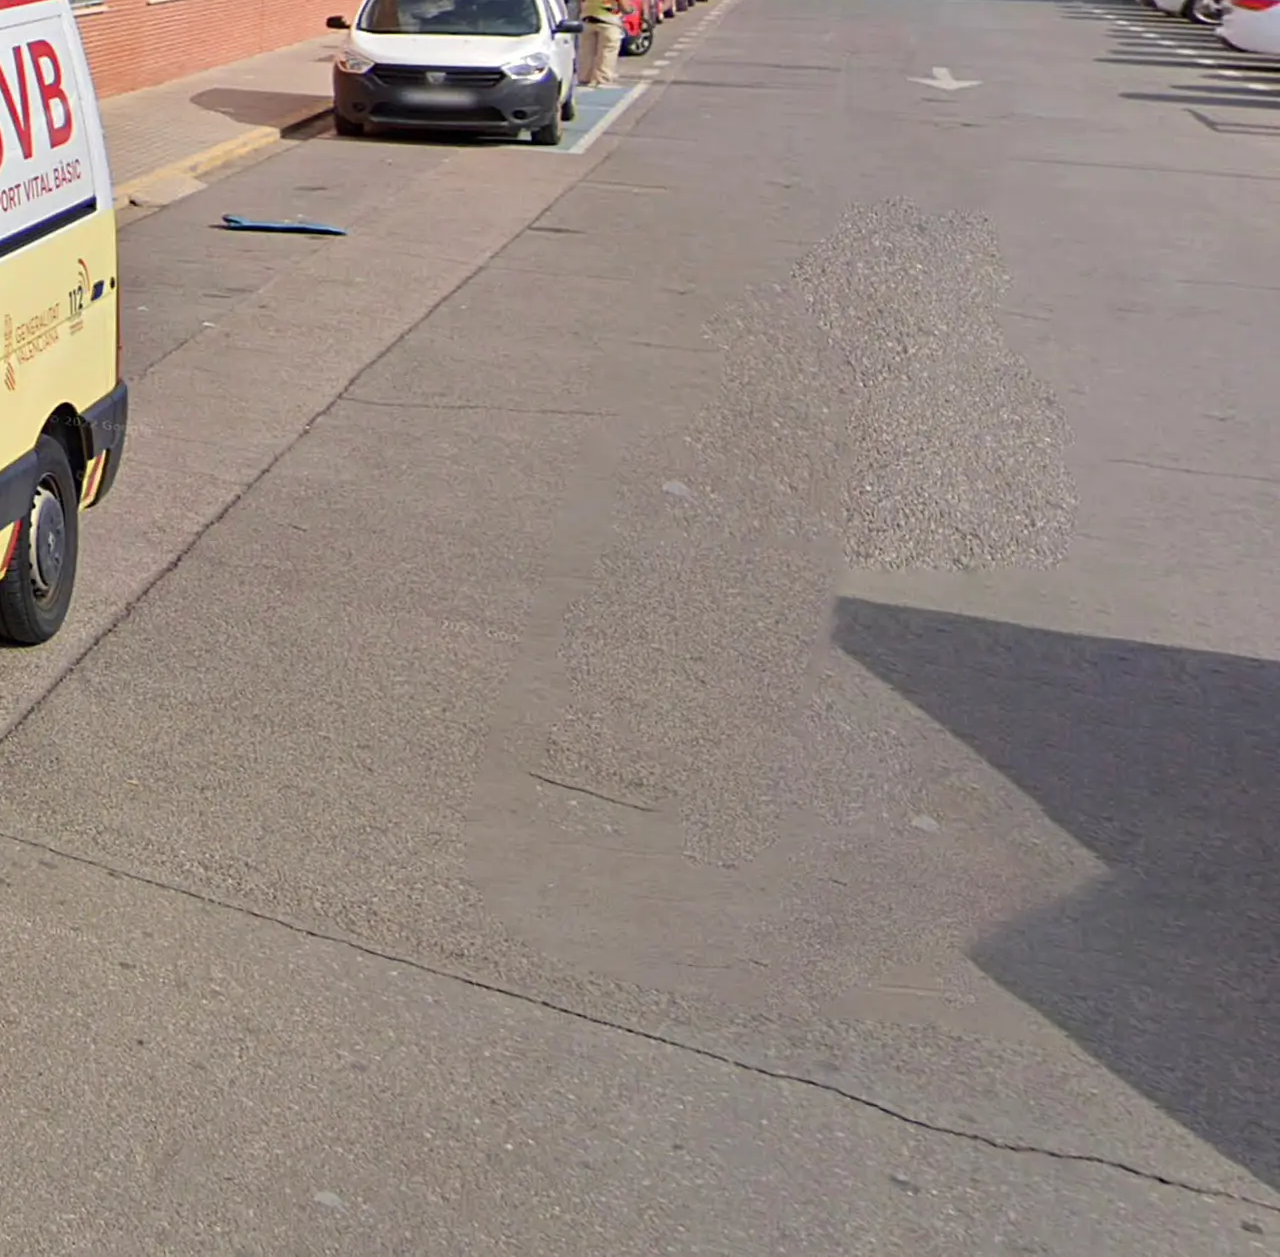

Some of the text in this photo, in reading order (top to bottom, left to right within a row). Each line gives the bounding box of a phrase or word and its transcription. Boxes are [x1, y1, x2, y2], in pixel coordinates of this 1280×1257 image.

[23, 171, 54, 202] VITAL
[54, 159, 82, 190] BÀSIC
[68, 285, 84, 316] 112
[16, 302, 60, 344] GENERALITAT
